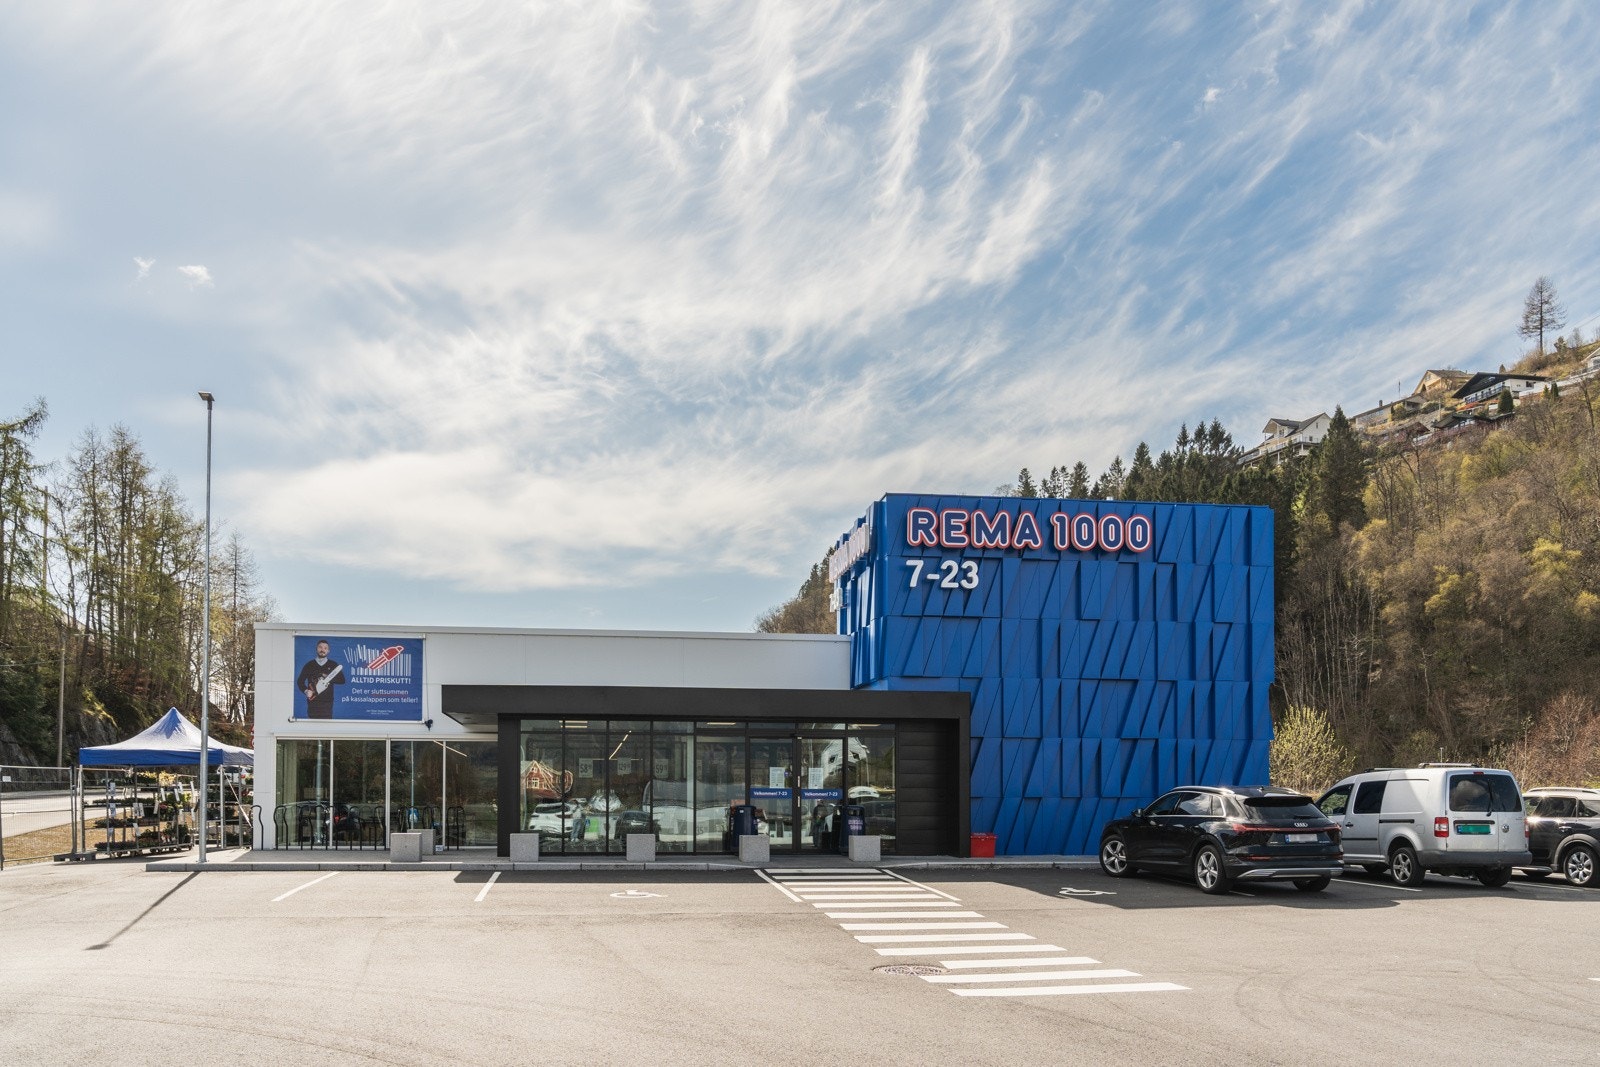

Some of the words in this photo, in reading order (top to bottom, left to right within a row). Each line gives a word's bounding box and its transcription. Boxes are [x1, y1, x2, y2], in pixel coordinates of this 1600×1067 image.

[907, 507, 1043, 548] REMA
[1050, 512, 1151, 553] 1000
[905, 559, 979, 589] 7-23
